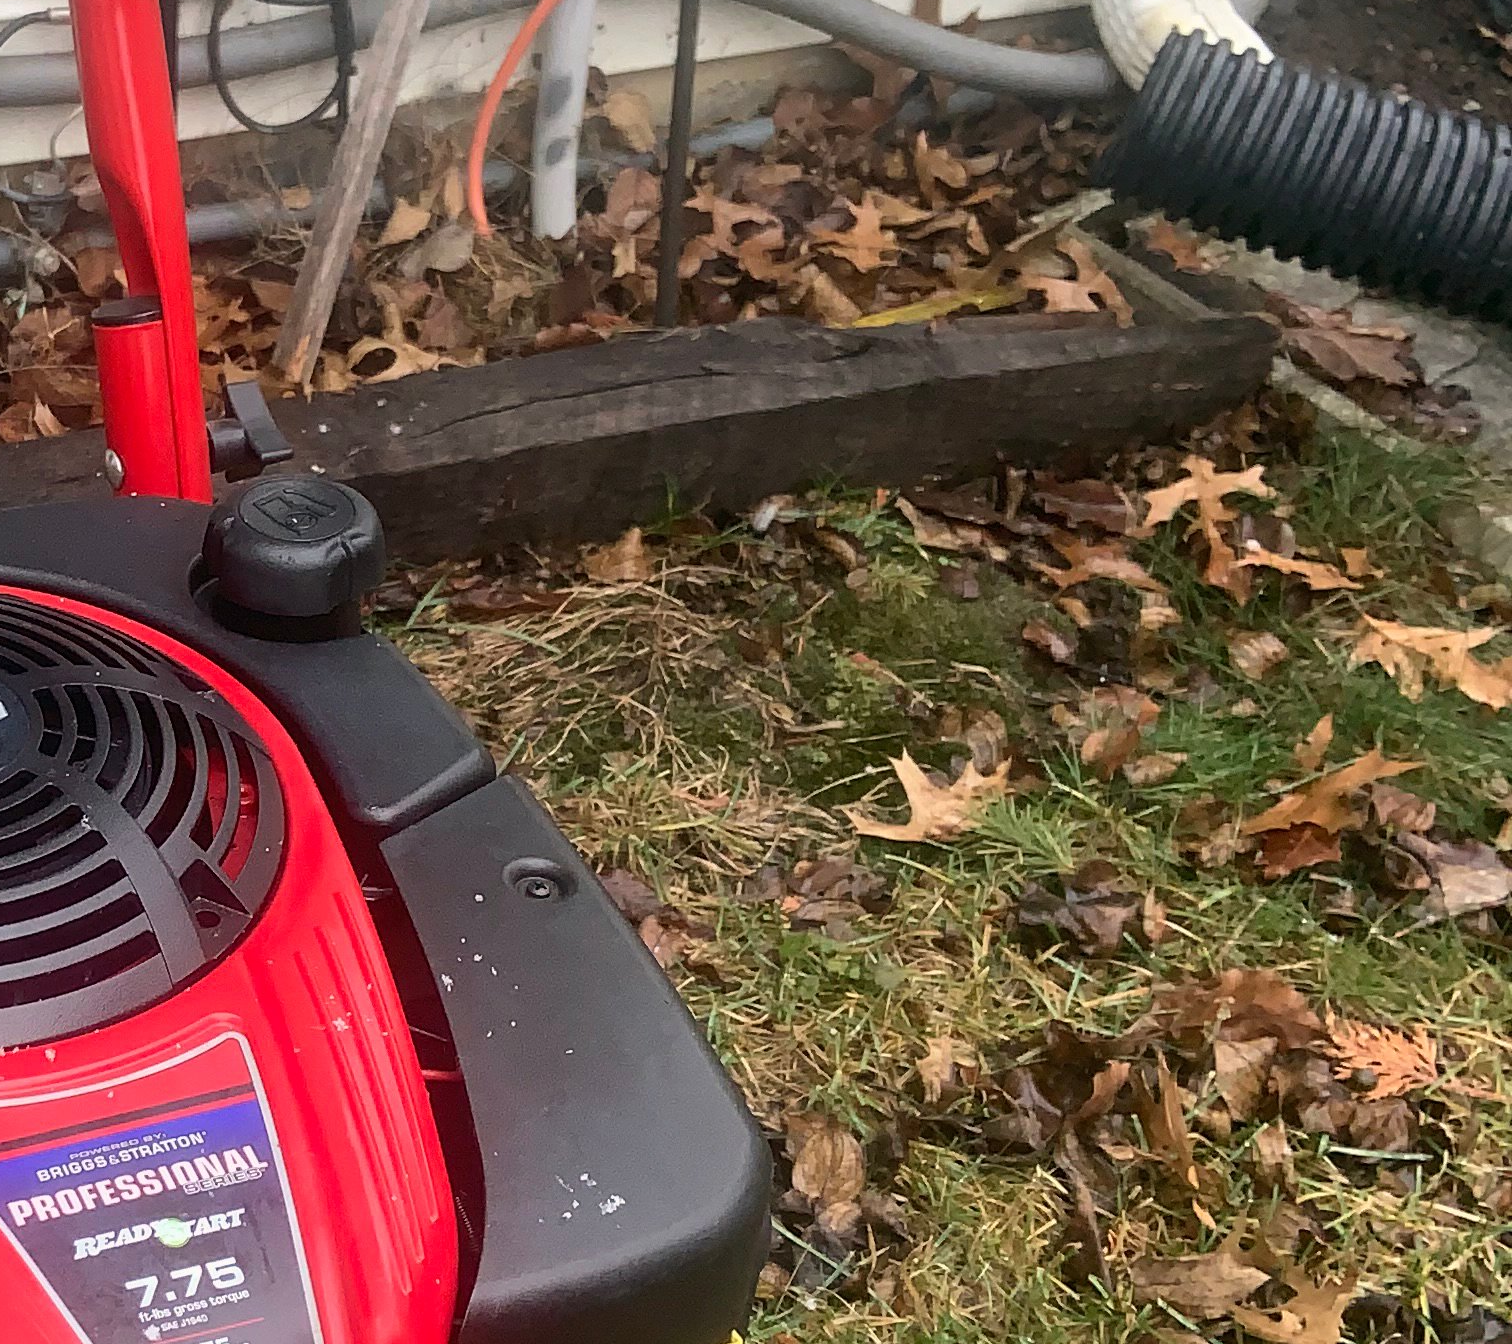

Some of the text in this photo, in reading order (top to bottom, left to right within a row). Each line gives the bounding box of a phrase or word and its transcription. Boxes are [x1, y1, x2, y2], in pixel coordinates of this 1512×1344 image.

[69, 1138, 139, 1160] POWERED
[6, 1144, 269, 1227] PROFESSIONAL
[183, 1167, 265, 1196] SERIES
[124, 1256, 245, 1308] 7.75
[174, 1299, 209, 1317] gross
[208, 1289, 250, 1307] torque
[160, 1322, 179, 1332] SAE
